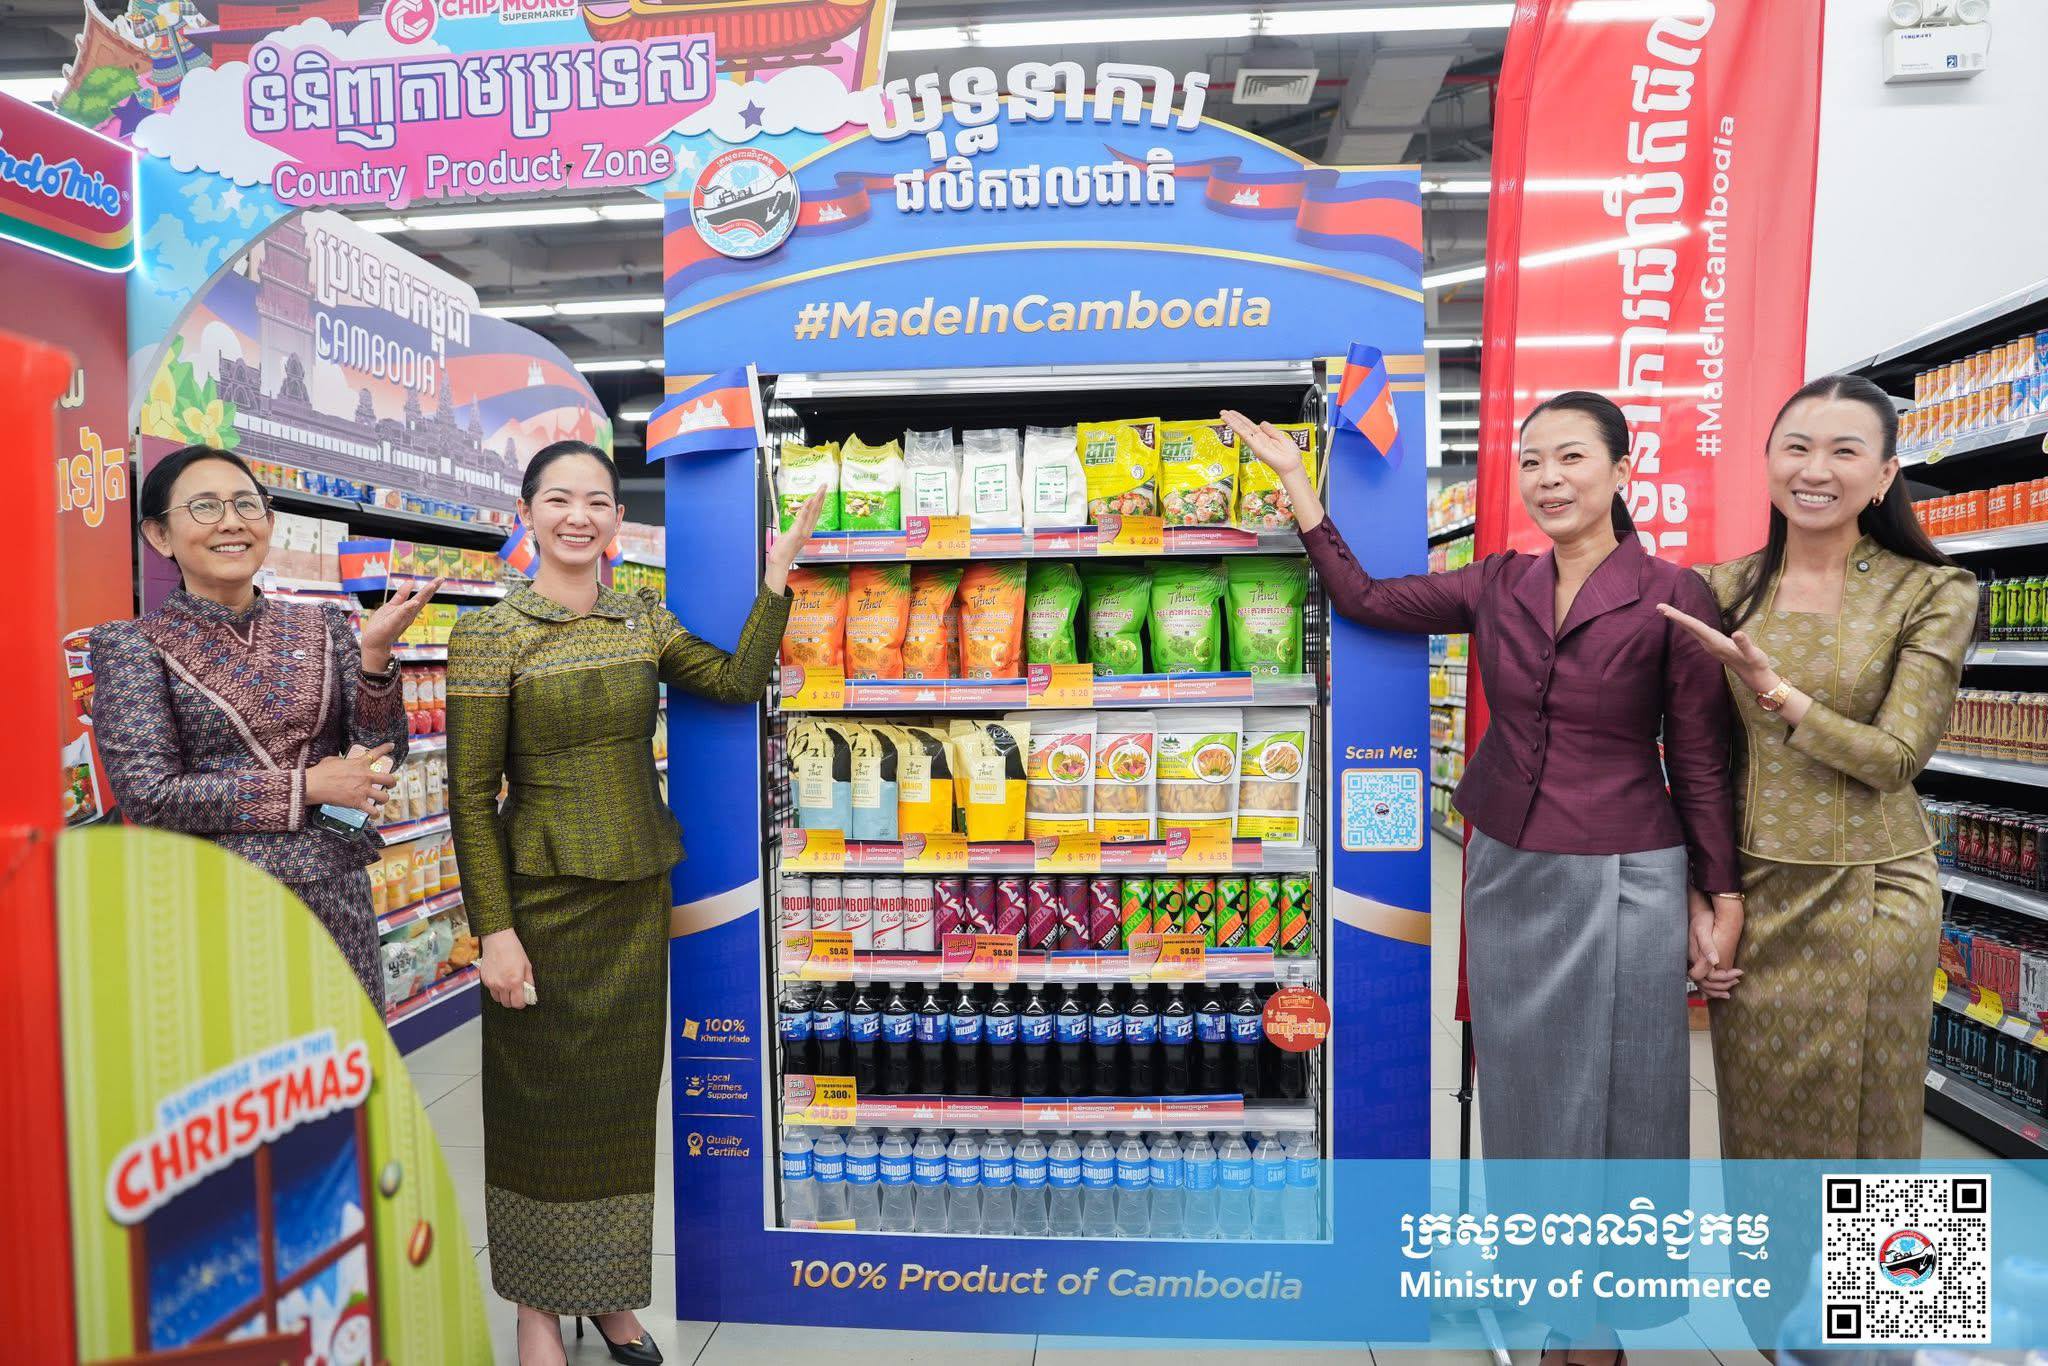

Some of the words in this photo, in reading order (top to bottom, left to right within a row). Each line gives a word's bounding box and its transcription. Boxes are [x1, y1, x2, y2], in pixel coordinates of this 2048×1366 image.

[502, 9, 575, 22] SUPERMARKET
[249, 41, 711, 149] ទំនិញតាមប្រទេស
[869, 59, 1210, 161] យុទ្ធនាការ
[274, 160, 407, 200] Country
[427, 148, 562, 189] Product
[582, 143, 671, 179] Zone
[0, 147, 120, 214] ndomie
[894, 147, 1177, 214] ផលិតផលជាតិ
[1696, 115, 1736, 457] #MadeInCambodia
[314, 228, 471, 369] ប្រទេសកម្ពុជា
[795, 286, 1271, 342] #MadeInCambodia
[315, 312, 436, 397] CAMBODIA
[1130, 537, 1136, 545] $
[1141, 537, 1159, 545] 2.20
[1345, 746, 1384, 759] Scan
[1389, 746, 1418, 759] Me:
[1079, 853, 1096, 861] 5.70
[829, 947, 849, 956] $0.45
[993, 949, 1013, 957] $0.50
[1180, 947, 1200, 955] $0.50
[705, 1018, 746, 1032] 100%
[863, 1018, 879, 1035] IZE
[895, 1019, 912, 1035] IZE
[997, 1021, 1014, 1037] IZE
[1033, 1021, 1050, 1037] IZE
[1071, 1020, 1087, 1037] IZE
[1107, 1021, 1123, 1037] IZE
[1178, 1021, 1193, 1037] IZE
[1238, 1020, 1256, 1036] IZE
[701, 1035, 727, 1043] Khmer
[728, 1035, 751, 1044] Made
[707, 1074, 731, 1082] Local
[707, 1083, 742, 1092] Farmers
[707, 1092, 749, 1101] Supported
[116, 1048, 365, 1209] CHRISTMAS
[706, 1135, 743, 1147] Quality
[706, 1147, 750, 1158] Certified
[790, 1259, 887, 1290] 100%
[899, 1262, 1046, 1296] Product
[1058, 1266, 1100, 1295] of
[1108, 1268, 1303, 1301] Cambodia
